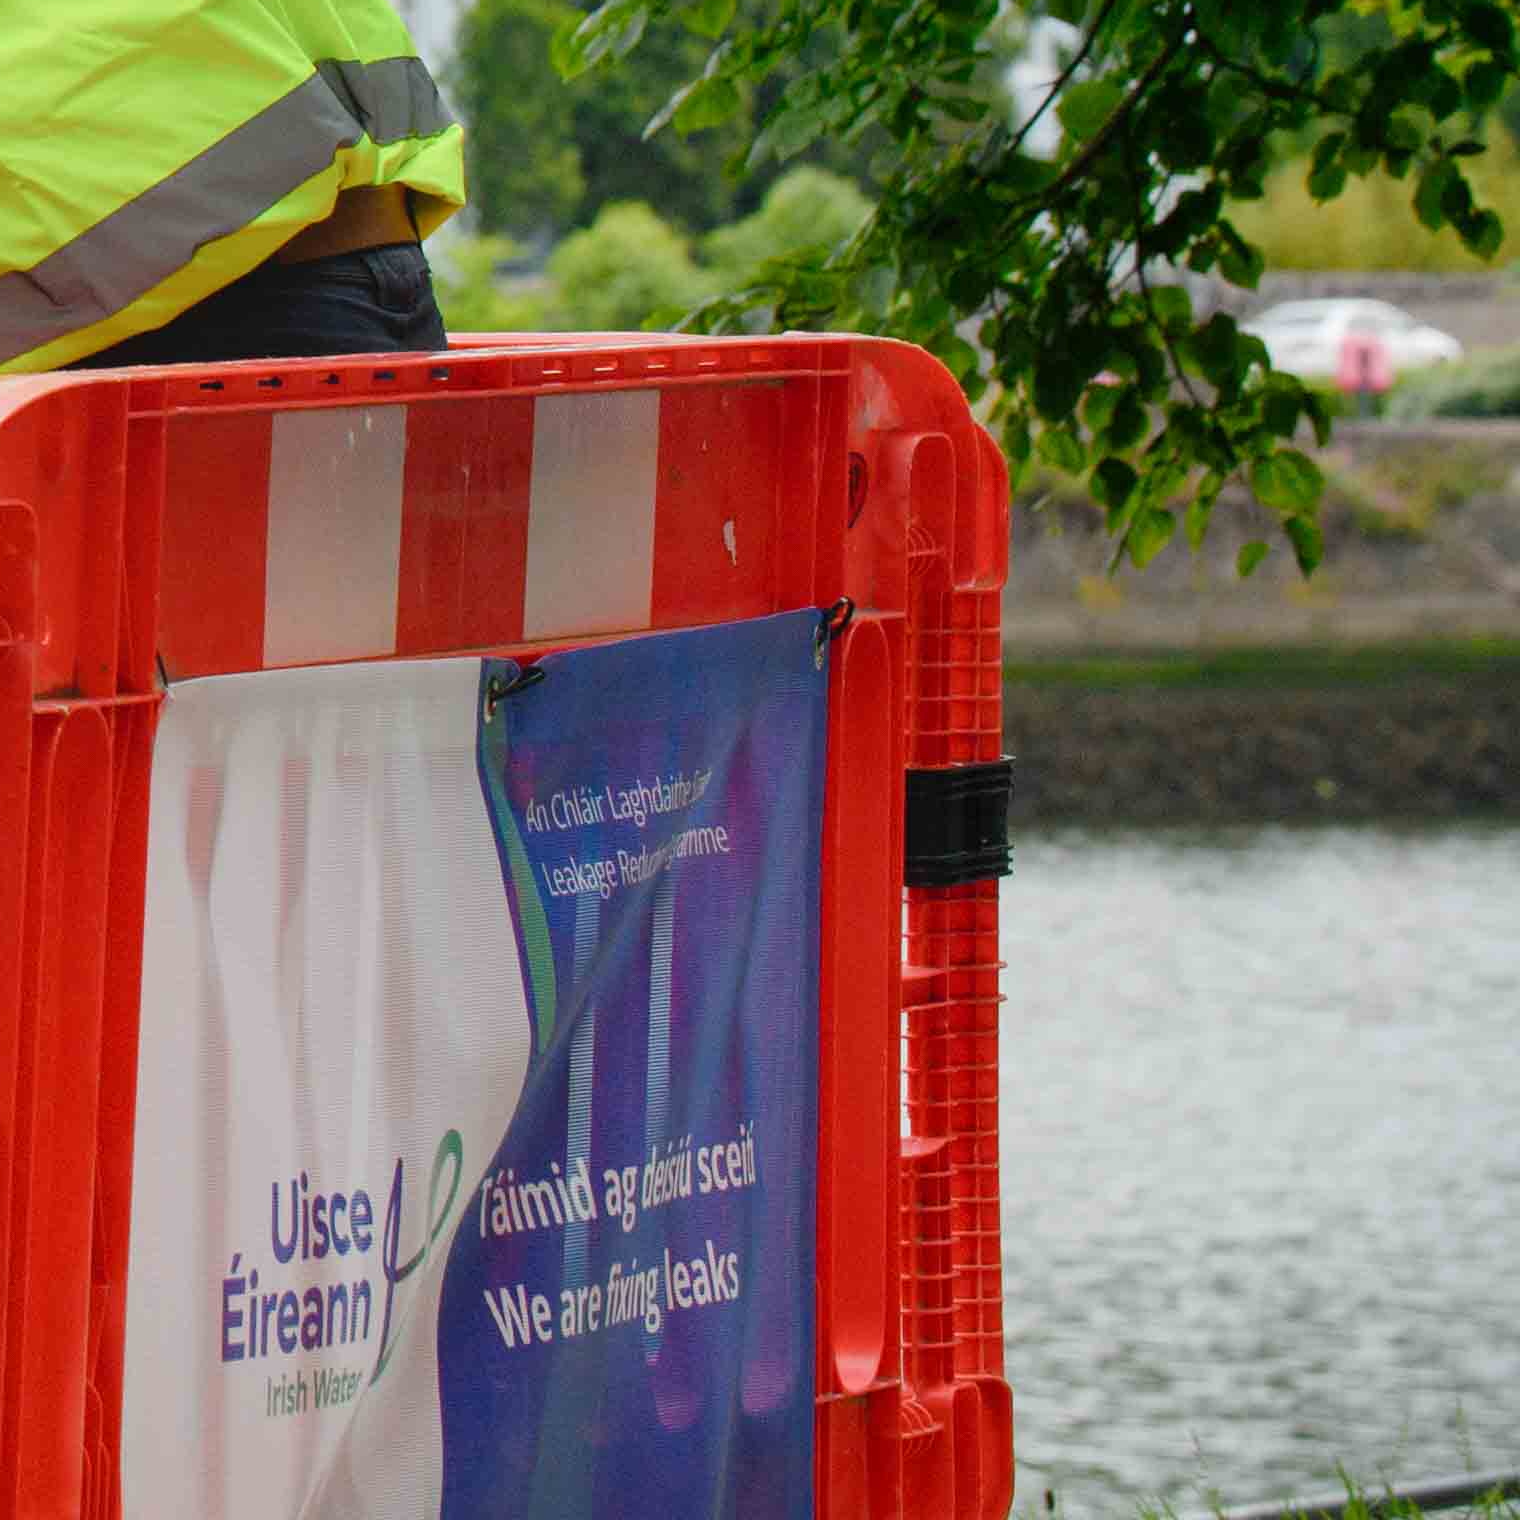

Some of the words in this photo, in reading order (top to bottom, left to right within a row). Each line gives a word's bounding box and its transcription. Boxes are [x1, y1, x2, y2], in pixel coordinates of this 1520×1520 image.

[525, 797, 550, 833] An
[551, 785, 606, 829] Chláir
[542, 856, 618, 900] Leakage
[271, 1169, 373, 1264] Uisce
[480, 1157, 598, 1238] Táimid
[603, 1165, 638, 1232] ag
[642, 1133, 693, 1210] deisiú
[222, 1253, 372, 1362] Éireann
[483, 1284, 553, 1349] We
[560, 1283, 602, 1337] are
[605, 1258, 662, 1333] fixing
[664, 1239, 739, 1310] leaks
[266, 1369, 307, 1417] Irish
